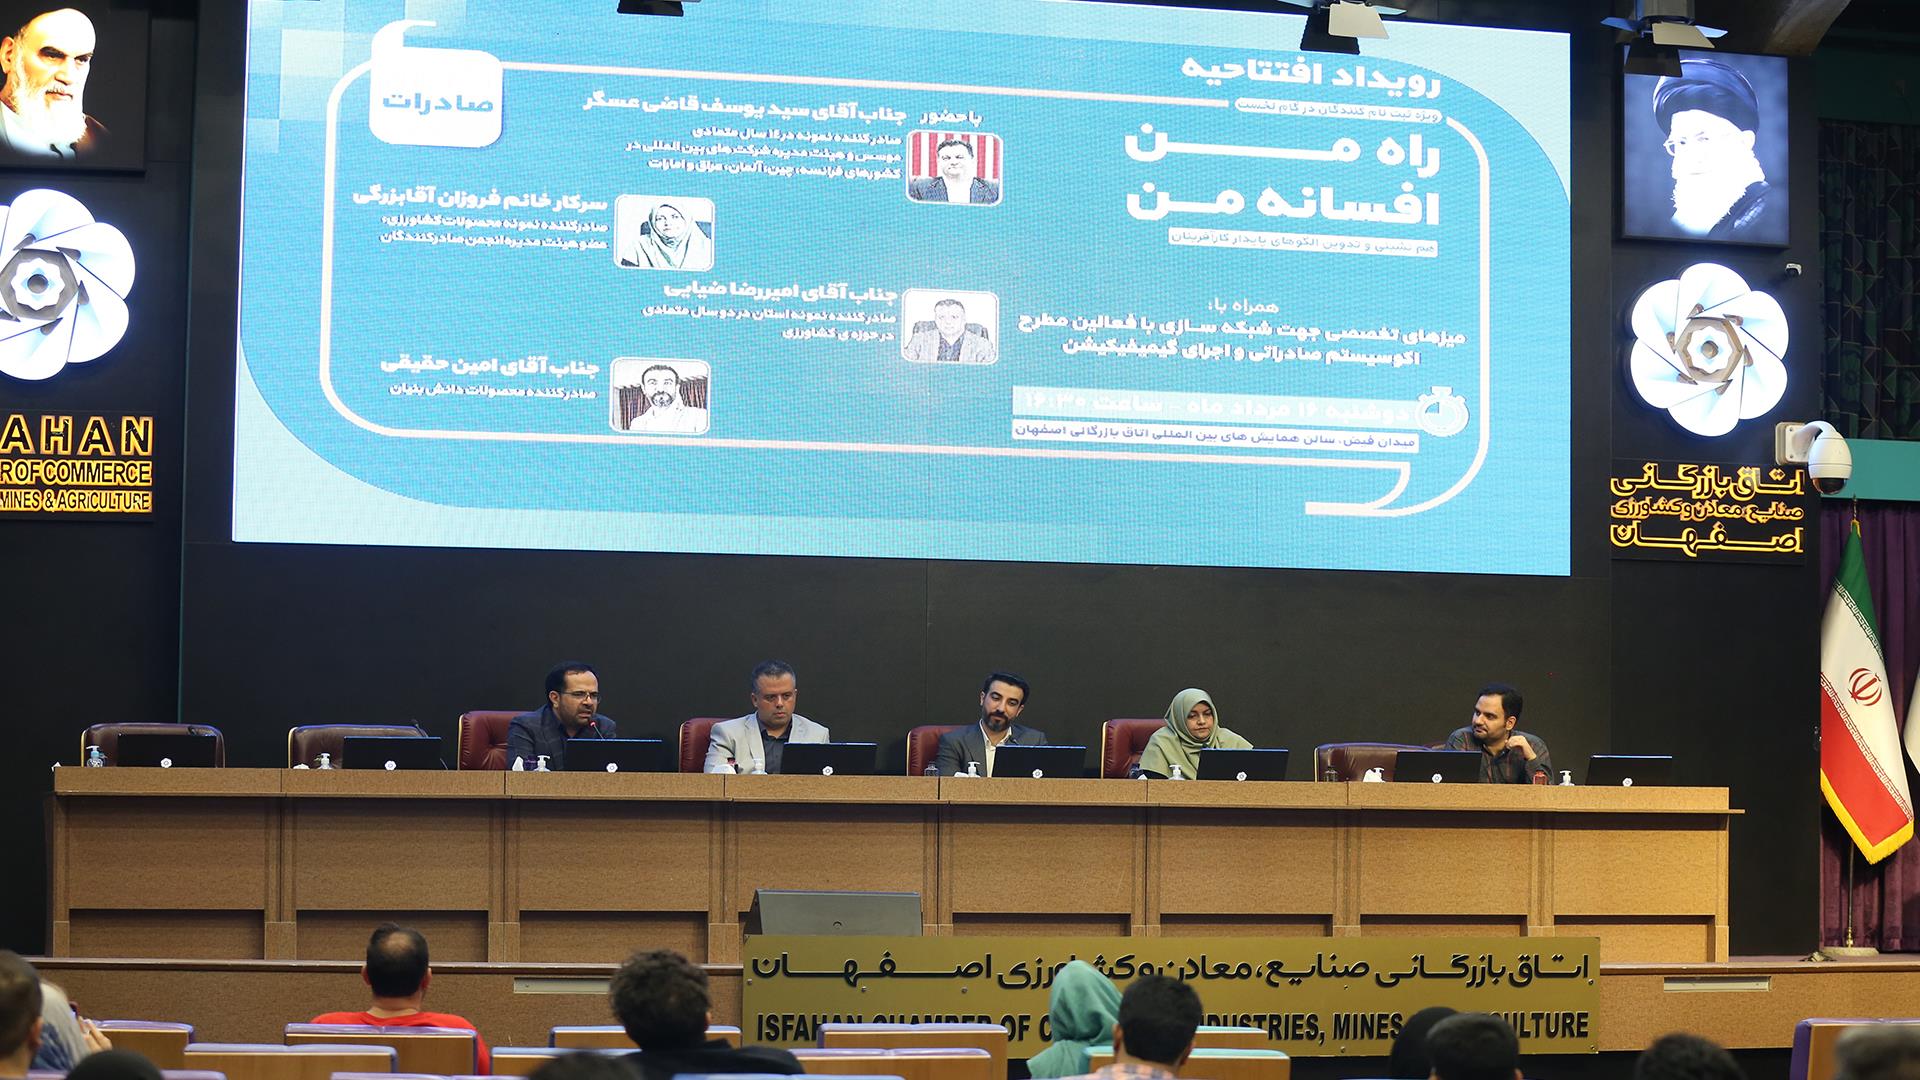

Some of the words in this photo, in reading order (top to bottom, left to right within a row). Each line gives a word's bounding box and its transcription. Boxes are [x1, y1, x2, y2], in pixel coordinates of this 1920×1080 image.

[1181, 55, 1323, 86] افتتاحیه
[1331, 65, 1441, 99] رویداد
[382, 92, 494, 115] صادرات
[583, 90, 640, 110] عسگر
[642, 95, 699, 112] قاضی
[701, 97, 765, 119] یوسف
[767, 103, 810, 120] سید
[812, 102, 858, 120] آقای
[858, 107, 907, 125] جناب
[1302, 106, 1316, 115] در
[691, 126, 739, 138] متمادی
[739, 128, 767, 140] سال
[642, 141, 681, 152] المللی
[1124, 122, 1361, 163] من
[1376, 133, 1441, 178] راه
[437, 188, 501, 209] فروزان
[503, 193, 551, 210] خانم
[552, 194, 608, 213] سرکار
[1126, 181, 1246, 221] من
[1256, 181, 1440, 226] افسانه
[664, 280, 727, 299] ضیایی
[730, 282, 799, 301] امیررضا
[801, 283, 849, 302] آقای
[850, 287, 898, 306] جناب
[641, 304, 690, 317] متمادی
[690, 306, 720, 319] سال
[1232, 298, 1280, 315] همراه
[1017, 312, 1069, 333] مطرح
[1071, 313, 1138, 333] فعالین
[1140, 316, 1156, 335] با
[1159, 318, 1217, 336] سازی
[1221, 320, 1273, 339] شبکه
[1275, 324, 1321, 342] جهت
[1324, 325, 1400, 342] تخصصی
[1401, 328, 1467, 347] میزهای
[1181, 343, 1231, 361] اجرای
[1232, 346, 1246, 361] و
[1249, 346, 1323, 362] صادراتی
[1324, 349, 1421, 368] اکوسیستم
[380, 354, 449, 373] حقیقی
[451, 358, 498, 375] امین
[500, 356, 548, 376] آقای
[549, 361, 600, 379] جناب
[1092, 393, 1163, 412] ساعت
[1187, 394, 1224, 414] ماه
[1231, 399, 1291, 419] مرداد
[1326, 402, 1410, 425] دوشنبه
[0, 414, 153, 456] AHAN
[1015, 423, 1066, 436] اصفهان
[1069, 424, 1119, 439] بازرگانی
[1122, 427, 1149, 438] اتاق
[1152, 429, 1193, 440] المللی
[1195, 430, 1217, 442] بین
[1220, 431, 1247, 442] های
[1250, 431, 1300, 444] همایش
[1303, 434, 1335, 445] سالن
[1377, 437, 1416, 448] میدان
[14, 460, 42, 485] OF
[43, 459, 152, 486] COMMERCE
[1610, 462, 1732, 499] بازرگانی
[1729, 466, 1805, 501] اتاق
[43, 489, 55, 512] &
[1693, 500, 1743, 522] معادن
[1610, 520, 1804, 558] اصفهان
[752, 950, 992, 988] اصفهان
[1374, 953, 1507, 988] بازرگانی
[1508, 953, 1590, 987] اتاق
[1000, 1014, 1031, 1042] OF
